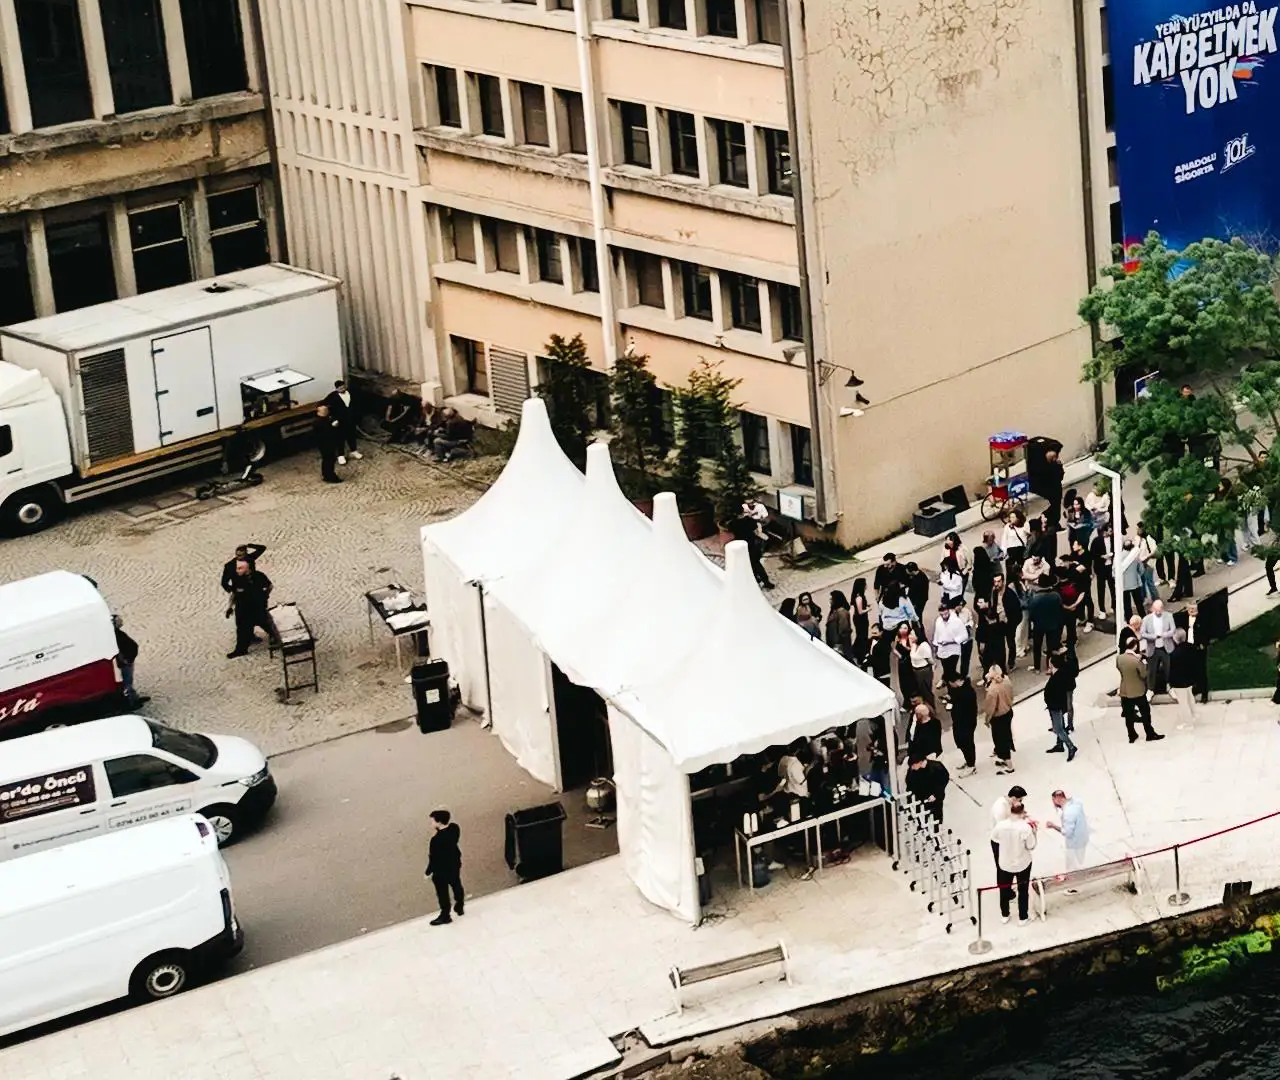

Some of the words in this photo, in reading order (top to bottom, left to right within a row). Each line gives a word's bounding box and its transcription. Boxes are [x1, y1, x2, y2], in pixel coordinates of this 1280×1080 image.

[1183, 4, 1241, 33] YÜZYILDA
[1242, 0, 1257, 15] DA
[1134, 6, 1279, 86] KAYBETMEK
[1179, 57, 1239, 115] YOK
[1174, 152, 1217, 174] ANADOLU
